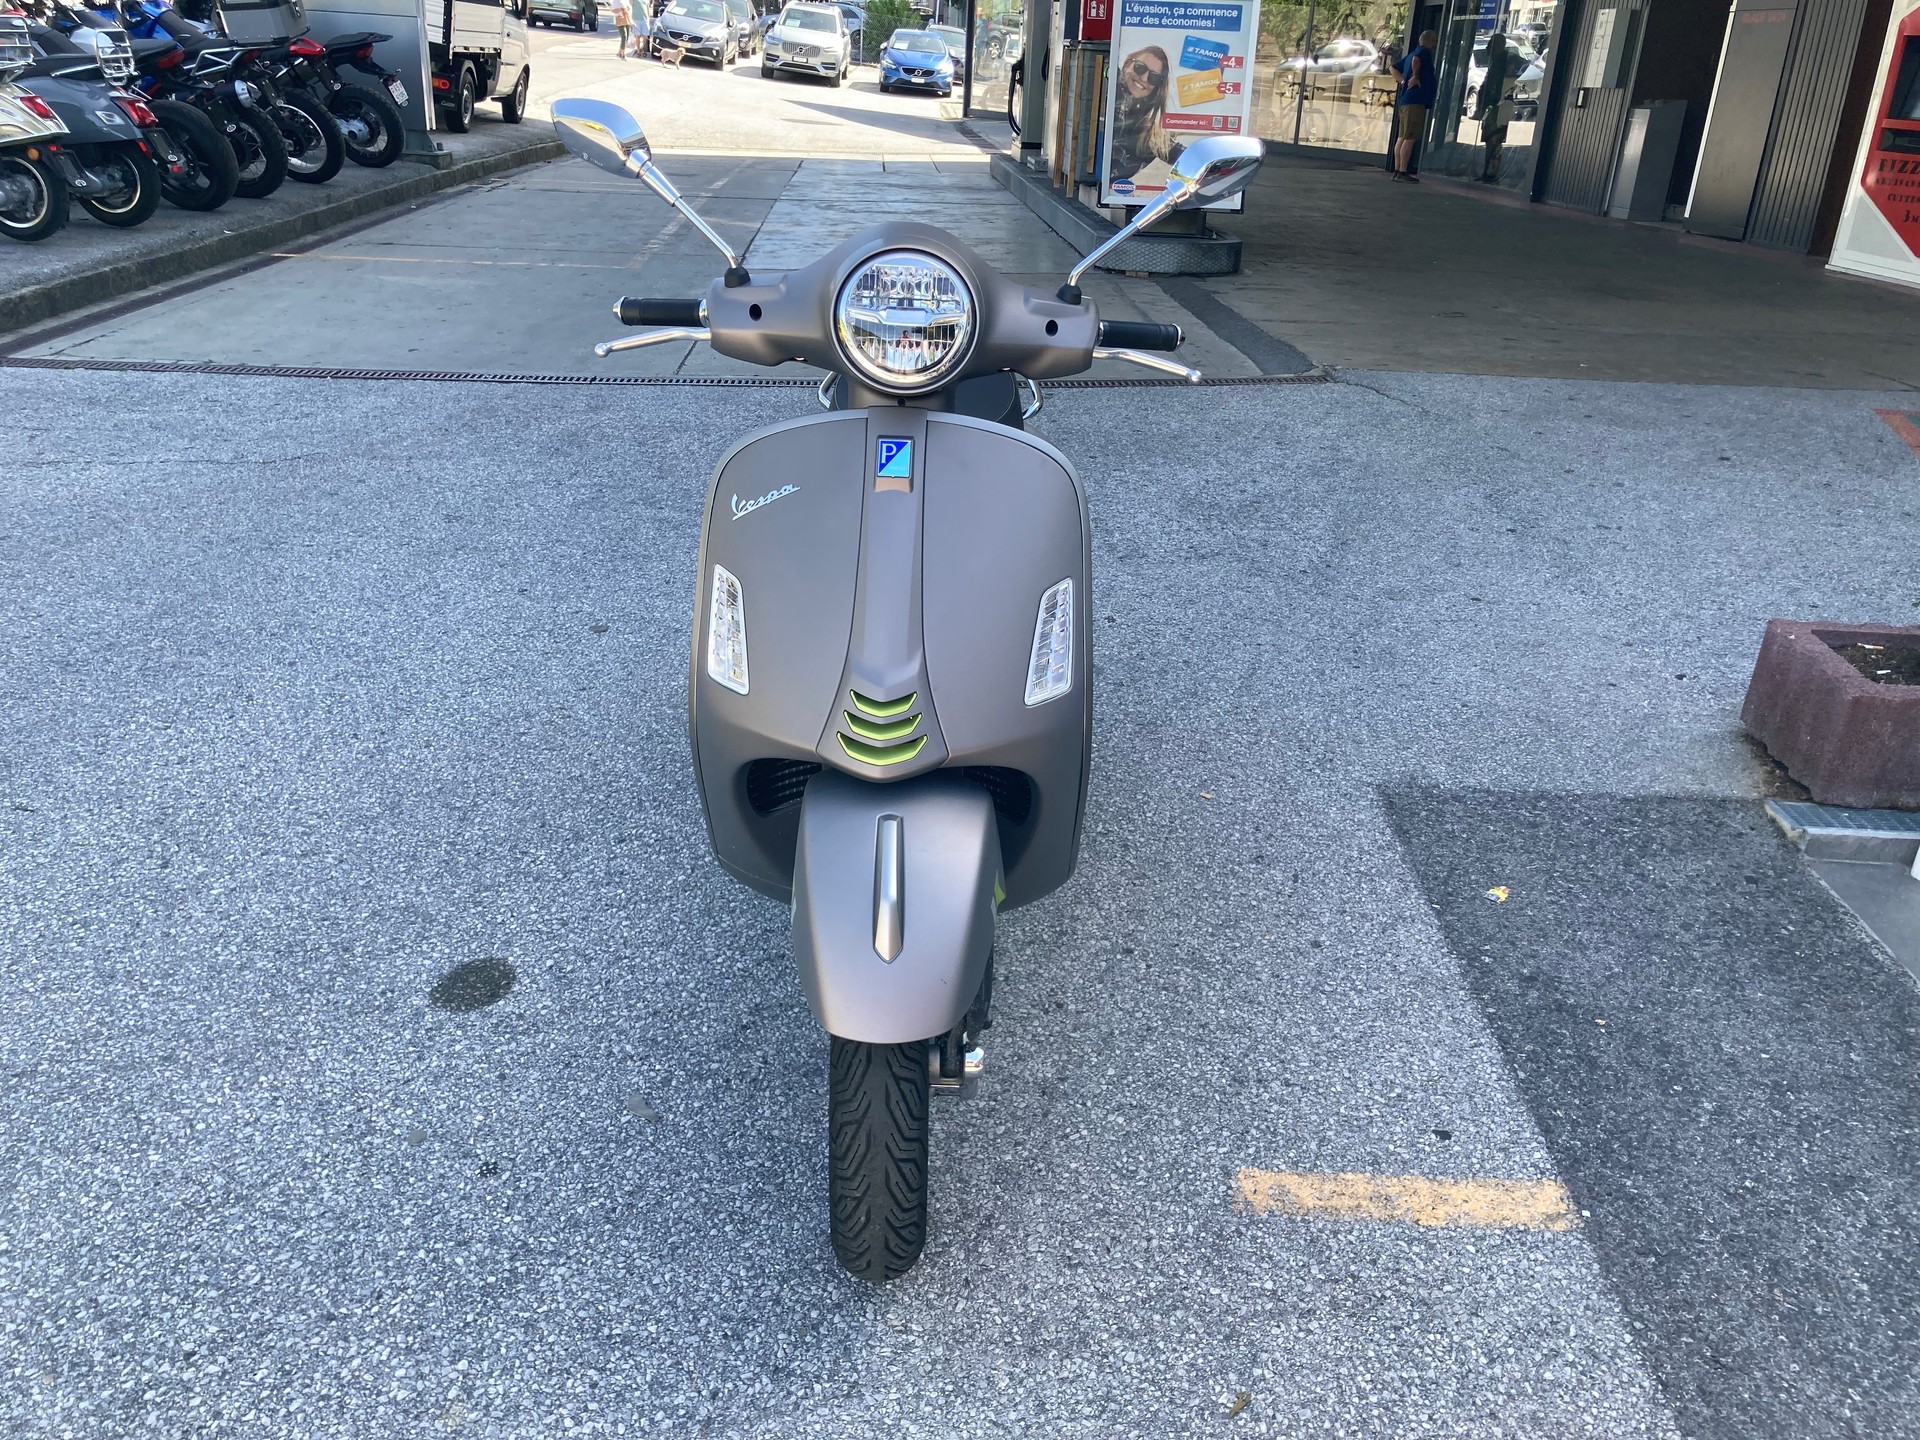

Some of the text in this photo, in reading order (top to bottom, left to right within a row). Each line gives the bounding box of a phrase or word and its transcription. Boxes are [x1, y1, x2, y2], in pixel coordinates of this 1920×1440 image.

[1126, 3, 1238, 17] L'évasion, ça commence
[1125, 16, 1140, 25] par
[1142, 15, 1159, 25] des
[1165, 118, 1198, 126] Commander
[881, 443, 897, 464] P
[731, 484, 801, 521] Vespa
